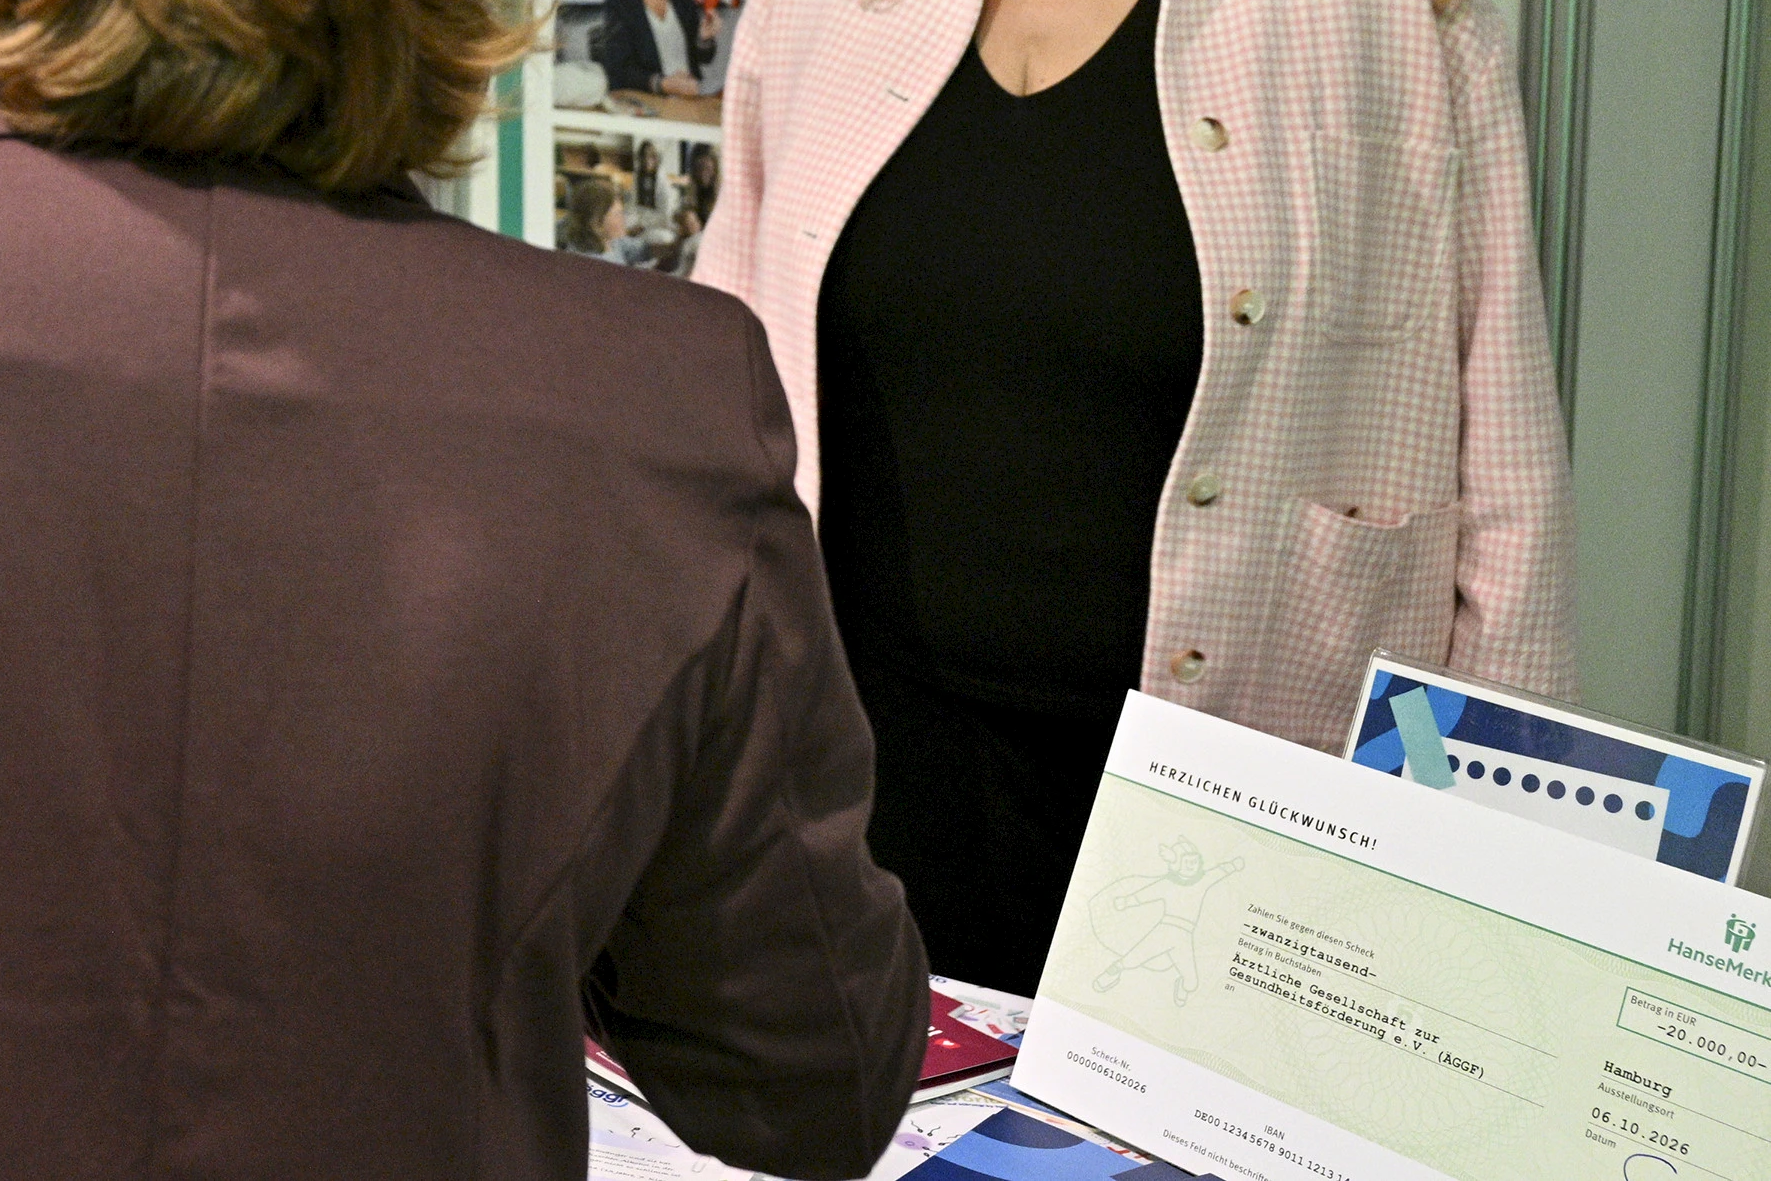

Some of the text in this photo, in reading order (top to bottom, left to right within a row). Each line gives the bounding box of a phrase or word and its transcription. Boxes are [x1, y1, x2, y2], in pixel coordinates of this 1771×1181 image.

[1149, 761, 1378, 851] HERZLICHEN GLÜCKWUNSCH!
[1247, 903, 1375, 960] Zahlen Sie gegen diesen Scheck
[1237, 937, 1322, 978] Betrag in Buchstaben
[1224, 982, 1235, 993] an
[1232, 951, 1441, 1045] Ärztliche Gesellschaft zur
[1229, 966, 1486, 1080] Gesundheitsförderung e.V. (ÄGGF)
[1630, 994, 1697, 1027] Betrag in EUR
[1067, 1050, 1147, 1094] 0000006102026
[1091, 1046, 1131, 1071] Scheck-Nr.
[1603, 1060, 1673, 1098] Hamburg
[1597, 1081, 1675, 1119] Ausstellungsort
[1162, 1128, 1189, 1148] Dieses
[1189, 1141, 1207, 1157] Feld
[1207, 1149, 1229, 1167] nicht
[1194, 1109, 1334, 1180] DE00 1234 5678 9011 1213
[1264, 1124, 1285, 1141] IBAN
[1585, 1128, 1617, 1149] Datum
[1591, 1106, 1690, 1156] 06.10.2026
